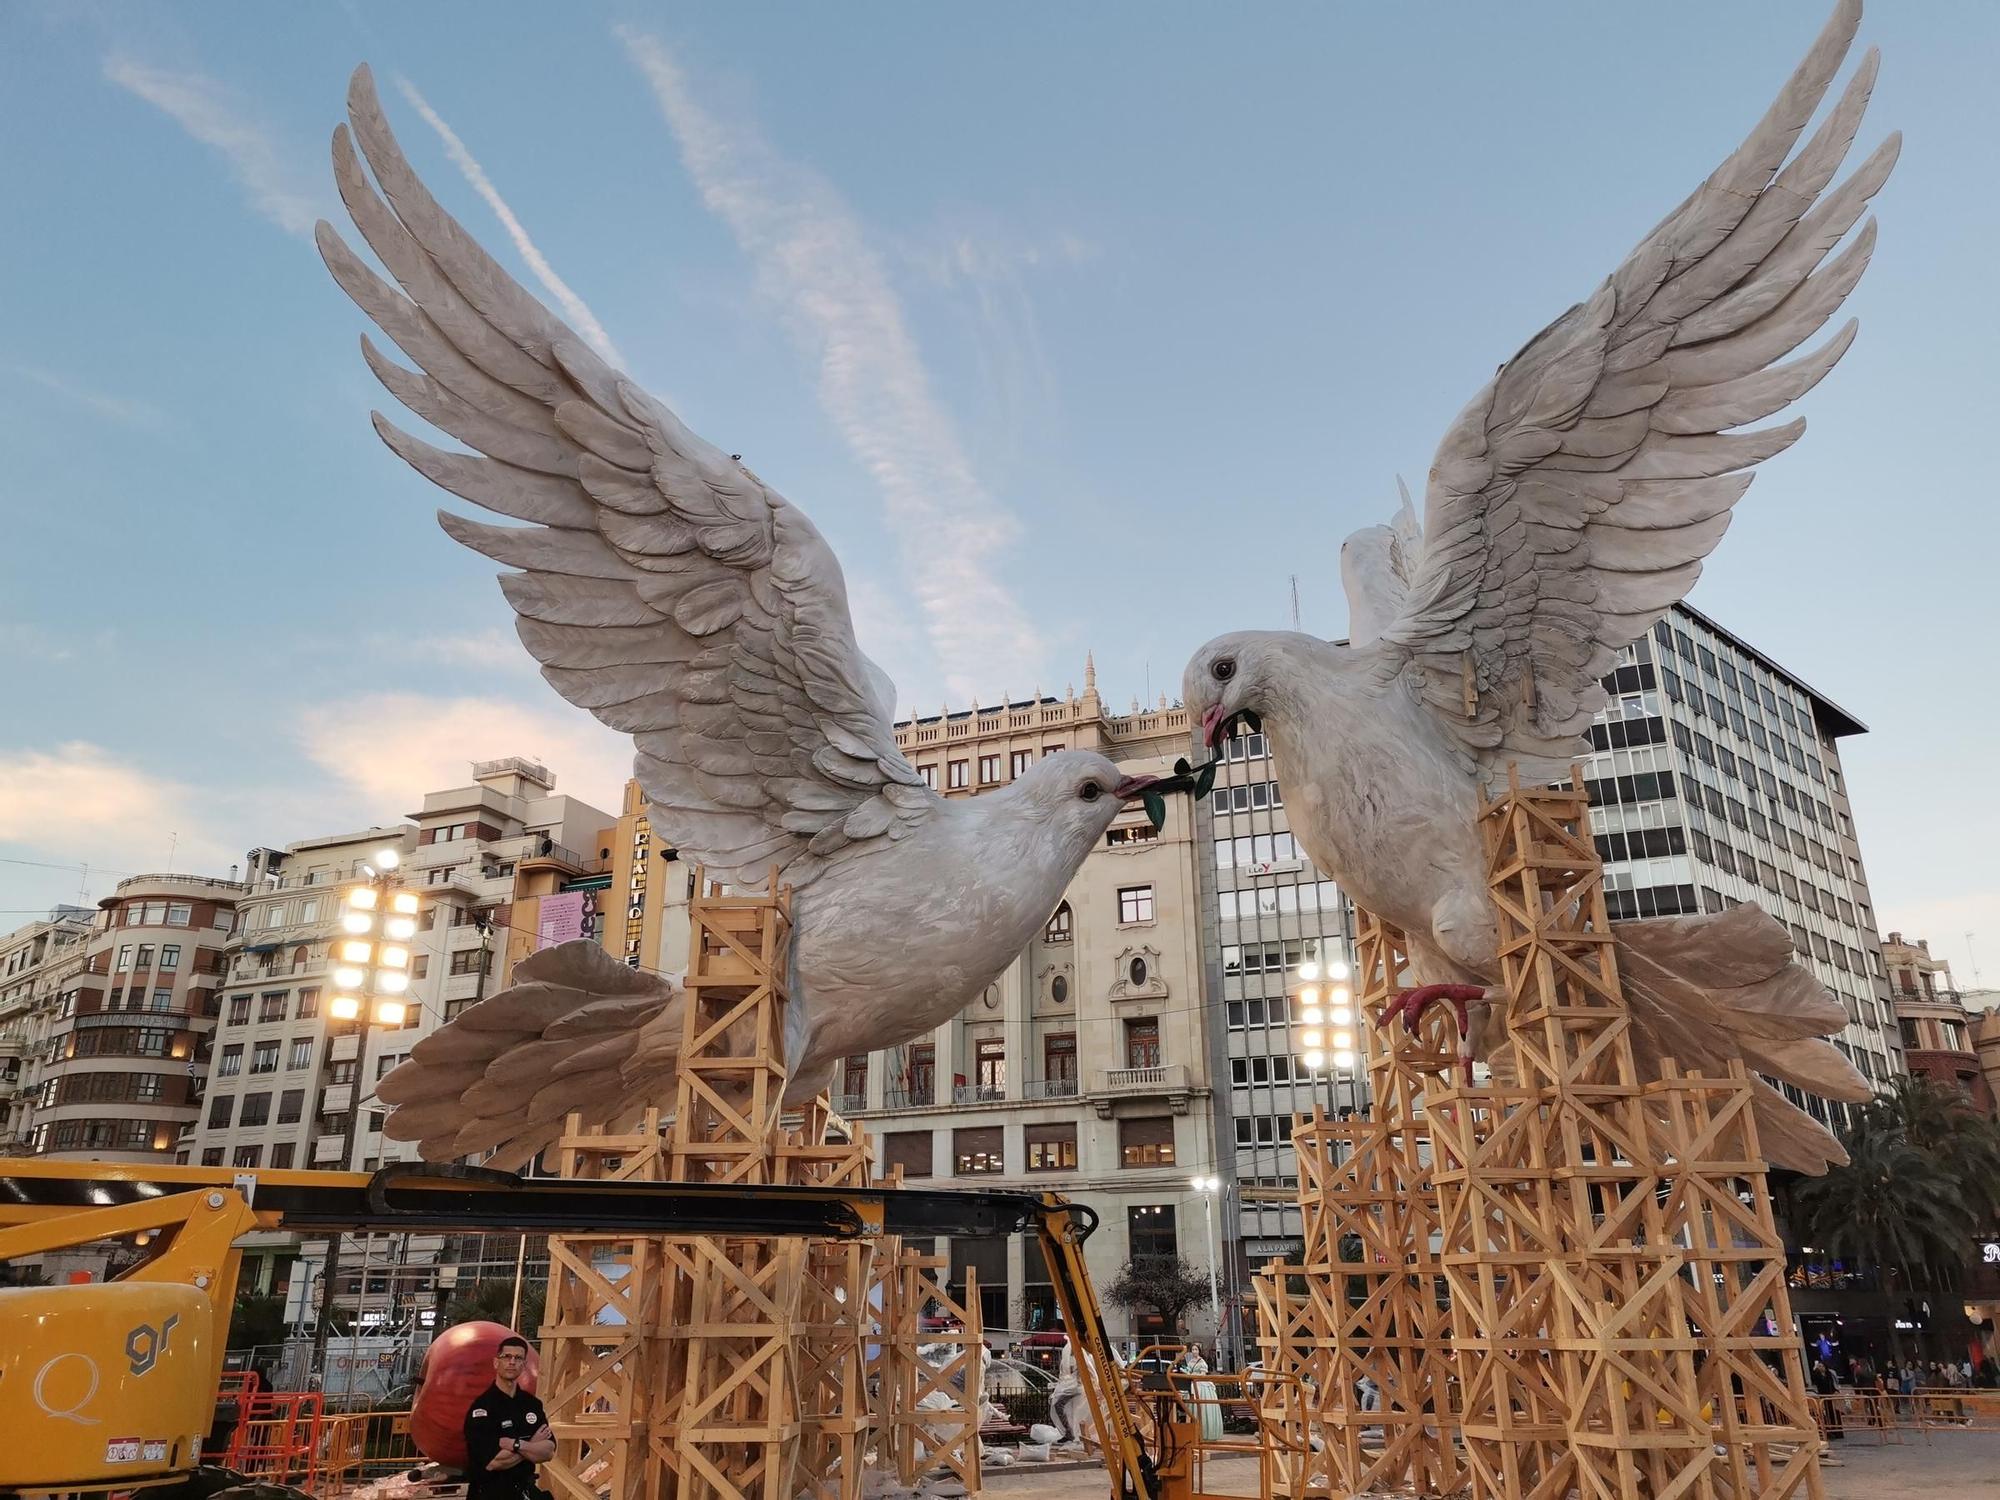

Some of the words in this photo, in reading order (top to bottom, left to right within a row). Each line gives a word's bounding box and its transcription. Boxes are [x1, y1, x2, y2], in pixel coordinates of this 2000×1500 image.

[628, 832, 650, 920] RIALTO
[34, 1353, 103, 1425] Q
[1094, 1337, 1112, 1382] CASTELLON
[1113, 1398, 1121, 1413] 421
